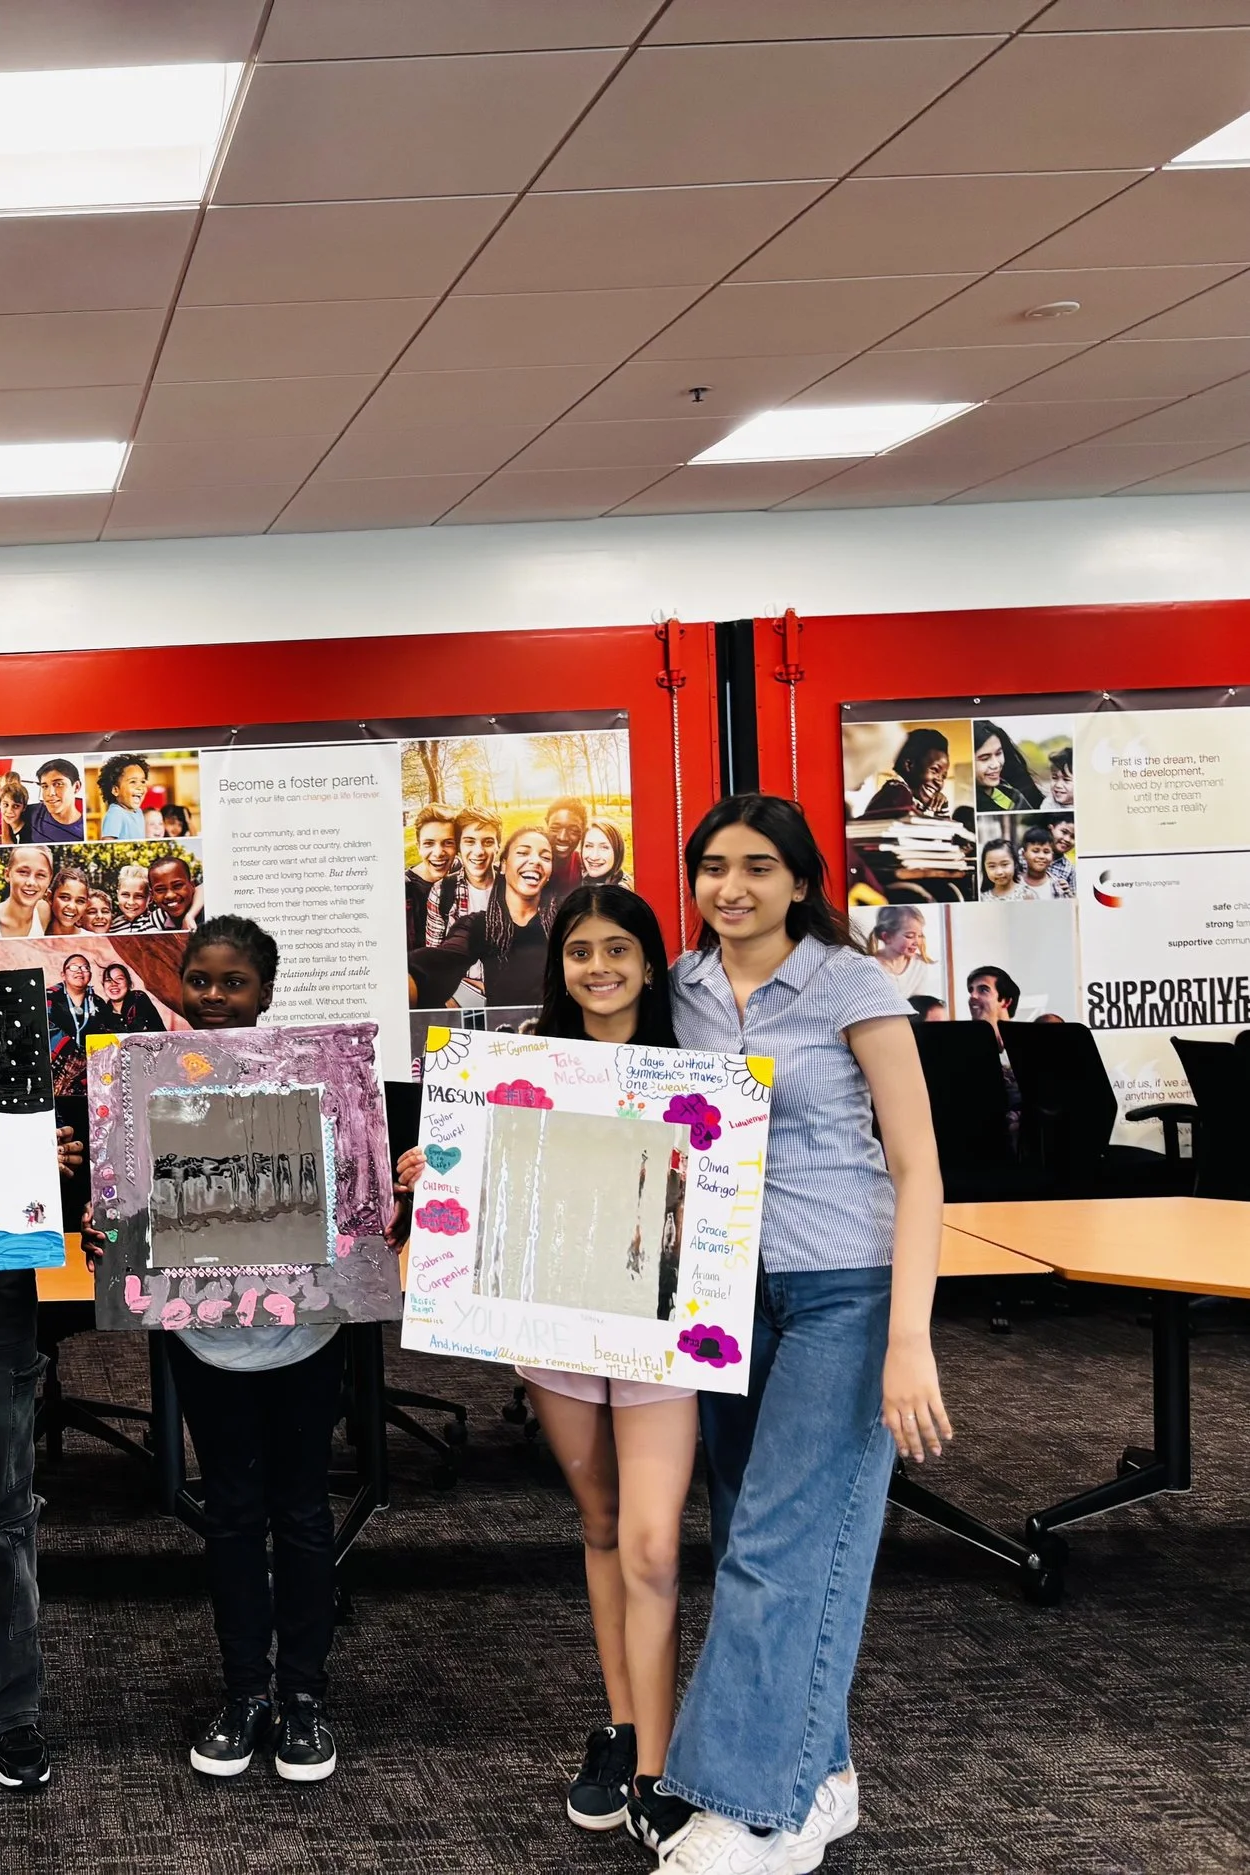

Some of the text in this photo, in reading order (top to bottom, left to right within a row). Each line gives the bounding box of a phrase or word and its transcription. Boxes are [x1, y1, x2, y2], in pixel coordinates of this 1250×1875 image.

[1111, 756, 1132, 766] First
[1134, 758, 1142, 766] is
[1145, 756, 1162, 765] the
[1198, 754, 1221, 764] then
[1123, 769, 1138, 778] the
[219, 774, 378, 792] Become a foster parent.
[1112, 880, 1134, 888] casey
[1213, 902, 1232, 911] safe
[1206, 920, 1234, 929] strong
[1168, 937, 1213, 948] supportive
[1087, 976, 1250, 1005] SUPPORTIVE
[548, 1052, 581, 1068] Tate
[640, 1050, 665, 1068] days
[673, 1056, 715, 1070] without
[626, 1066, 723, 1083] gymnastics makes
[626, 1080, 649, 1090] one
[424, 1112, 454, 1127] Taylor
[423, 1180, 460, 1194] CHIPOTLE
[696, 1218, 728, 1238] Gracie
[412, 1250, 454, 1271] Sabrina
[416, 1264, 469, 1293] Carpenter
[452, 1300, 507, 1340] YOU
[516, 1316, 570, 1356] ARE
[545, 1358, 598, 1374] remember
